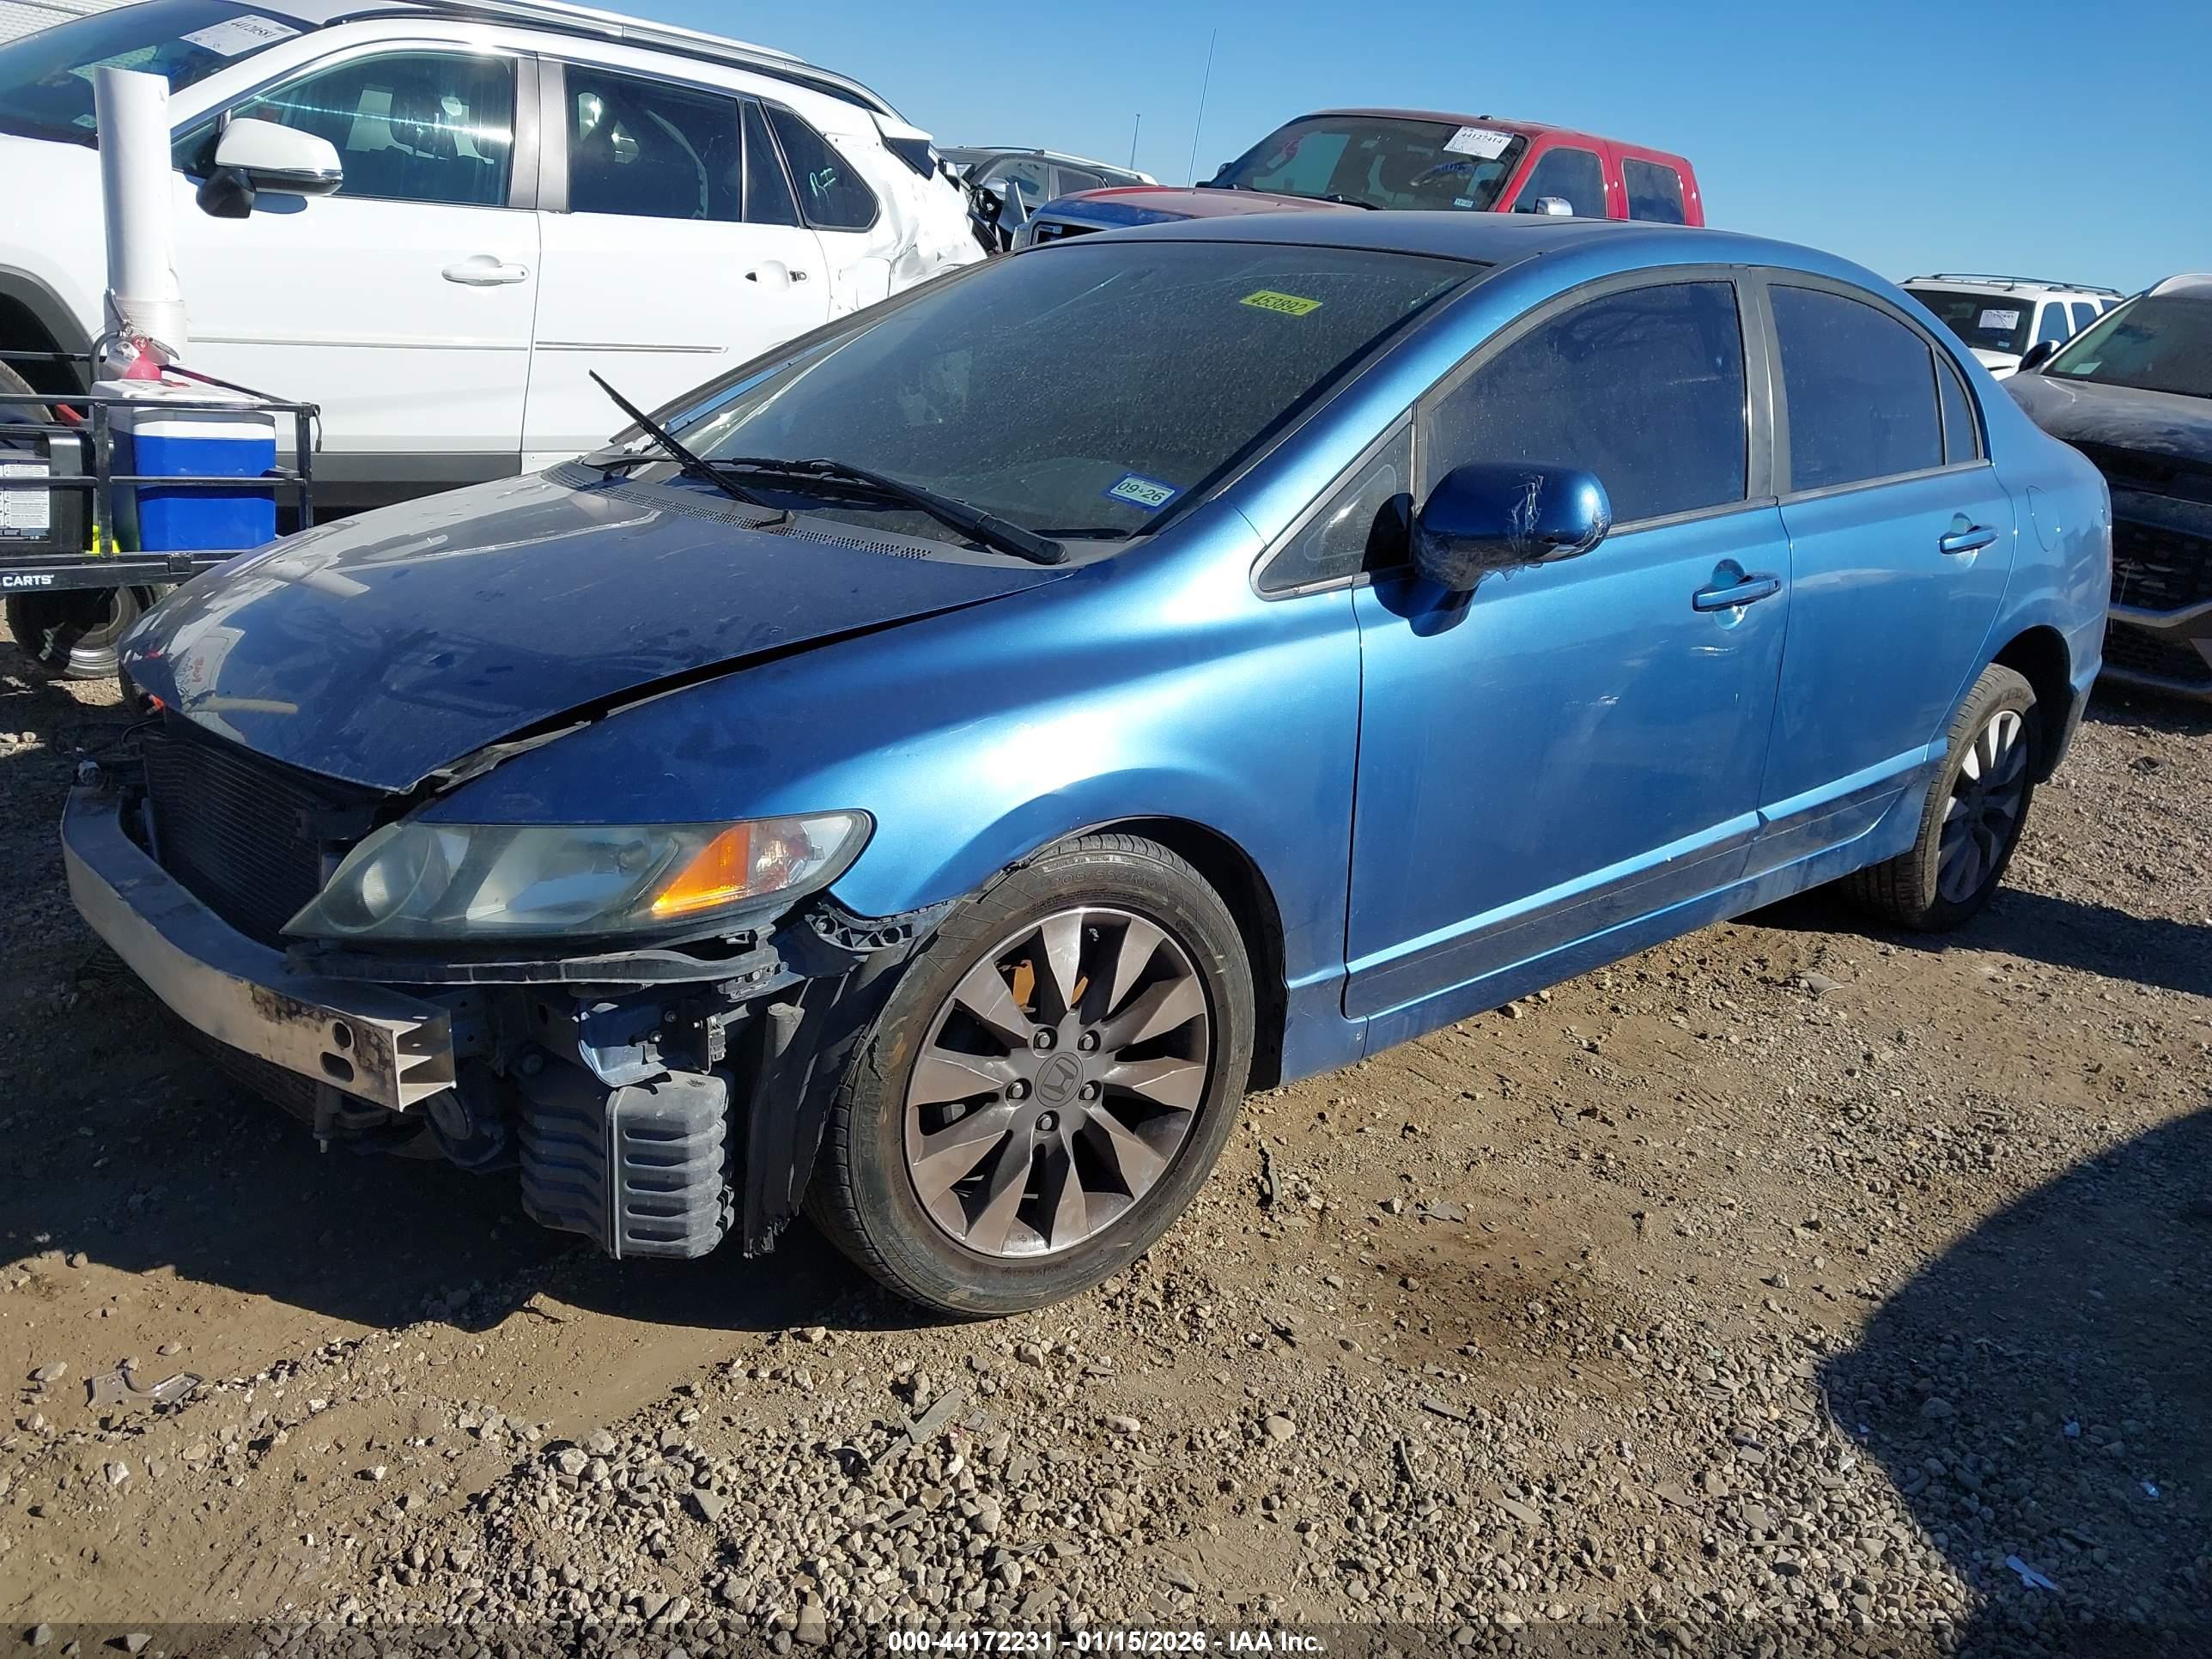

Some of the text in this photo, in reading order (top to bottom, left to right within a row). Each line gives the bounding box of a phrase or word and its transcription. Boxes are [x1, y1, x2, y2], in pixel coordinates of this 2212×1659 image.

[1250, 295, 1309, 313] 453892
[1117, 482, 1166, 501] 09 26
[2, 574, 52, 587] CARTS
